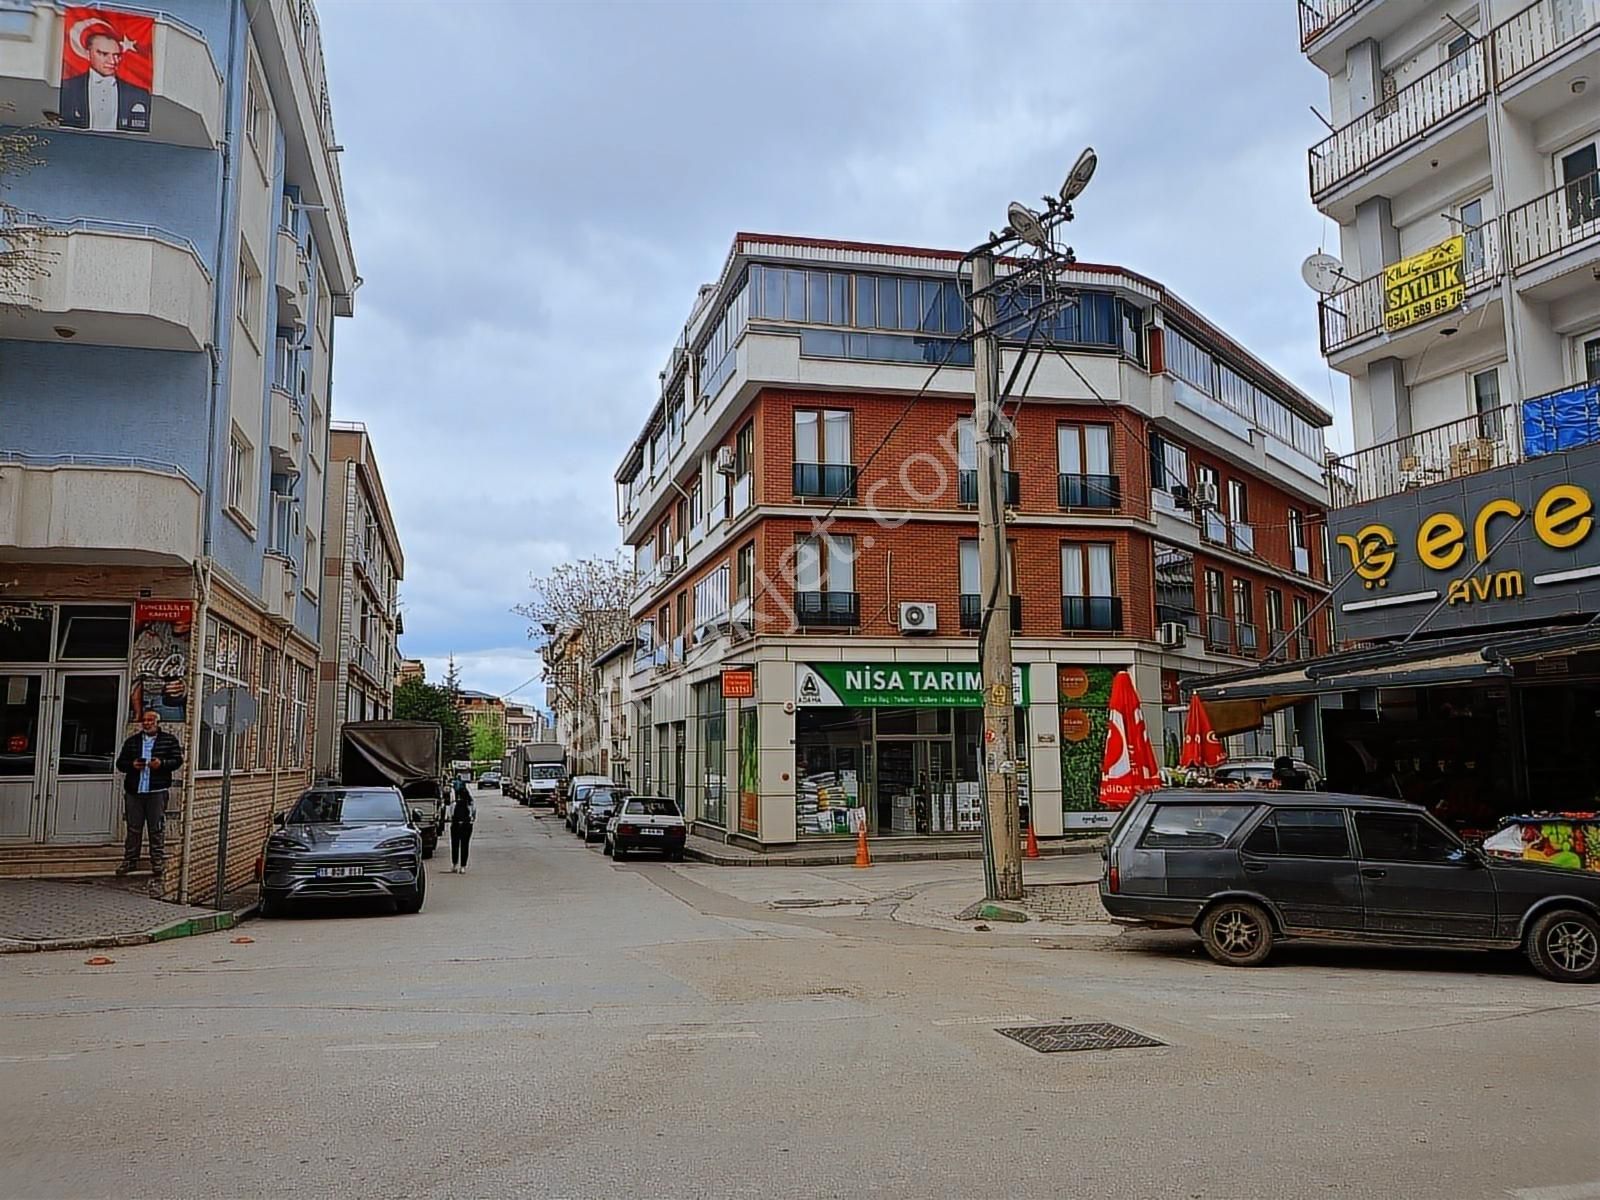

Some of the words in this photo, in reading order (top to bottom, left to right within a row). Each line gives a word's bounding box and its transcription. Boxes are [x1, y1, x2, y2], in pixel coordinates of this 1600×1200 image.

[1389, 262, 1459, 310] SATILIK
[845, 665, 905, 691] NİSA
[909, 670, 983, 691] TARIM
